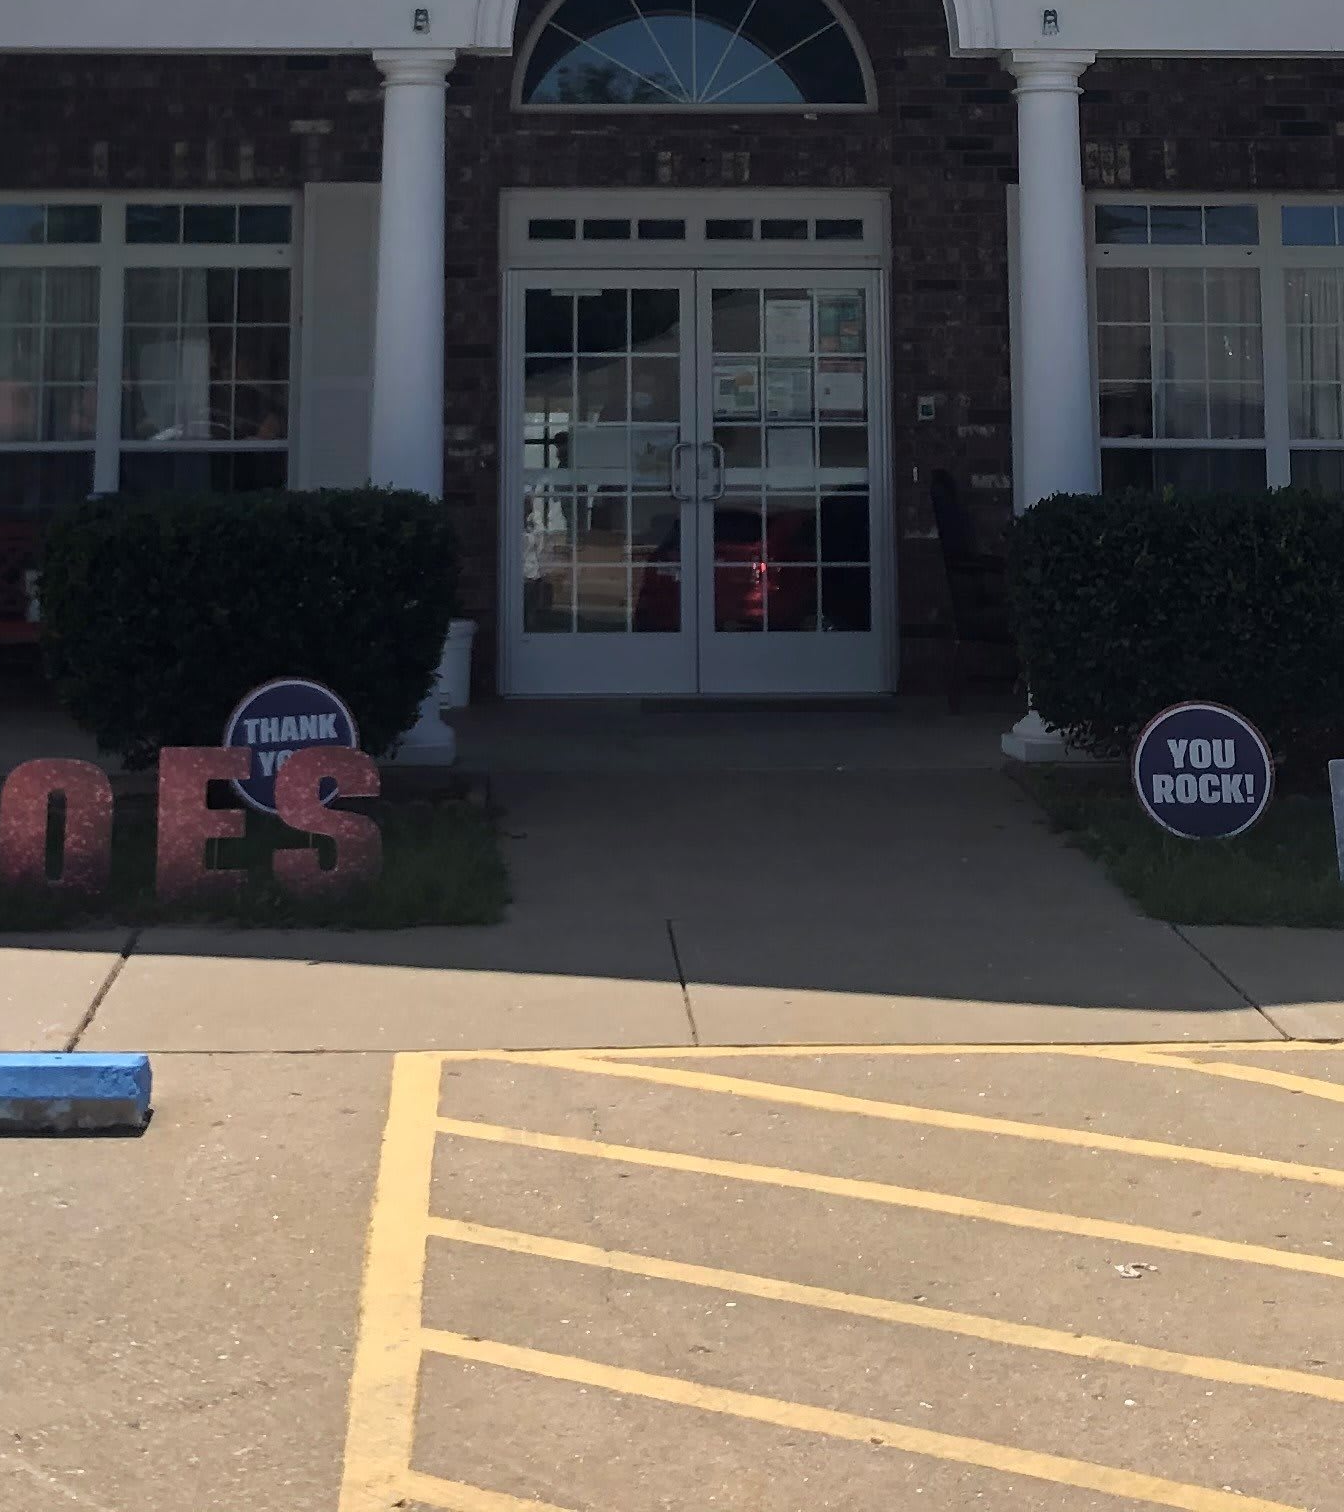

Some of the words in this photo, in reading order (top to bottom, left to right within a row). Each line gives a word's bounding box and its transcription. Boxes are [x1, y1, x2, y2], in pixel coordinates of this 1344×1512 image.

[243, 713, 339, 745] THANK
[1166, 737, 1236, 770] YOU
[1152, 772, 1256, 805] ROCK!
